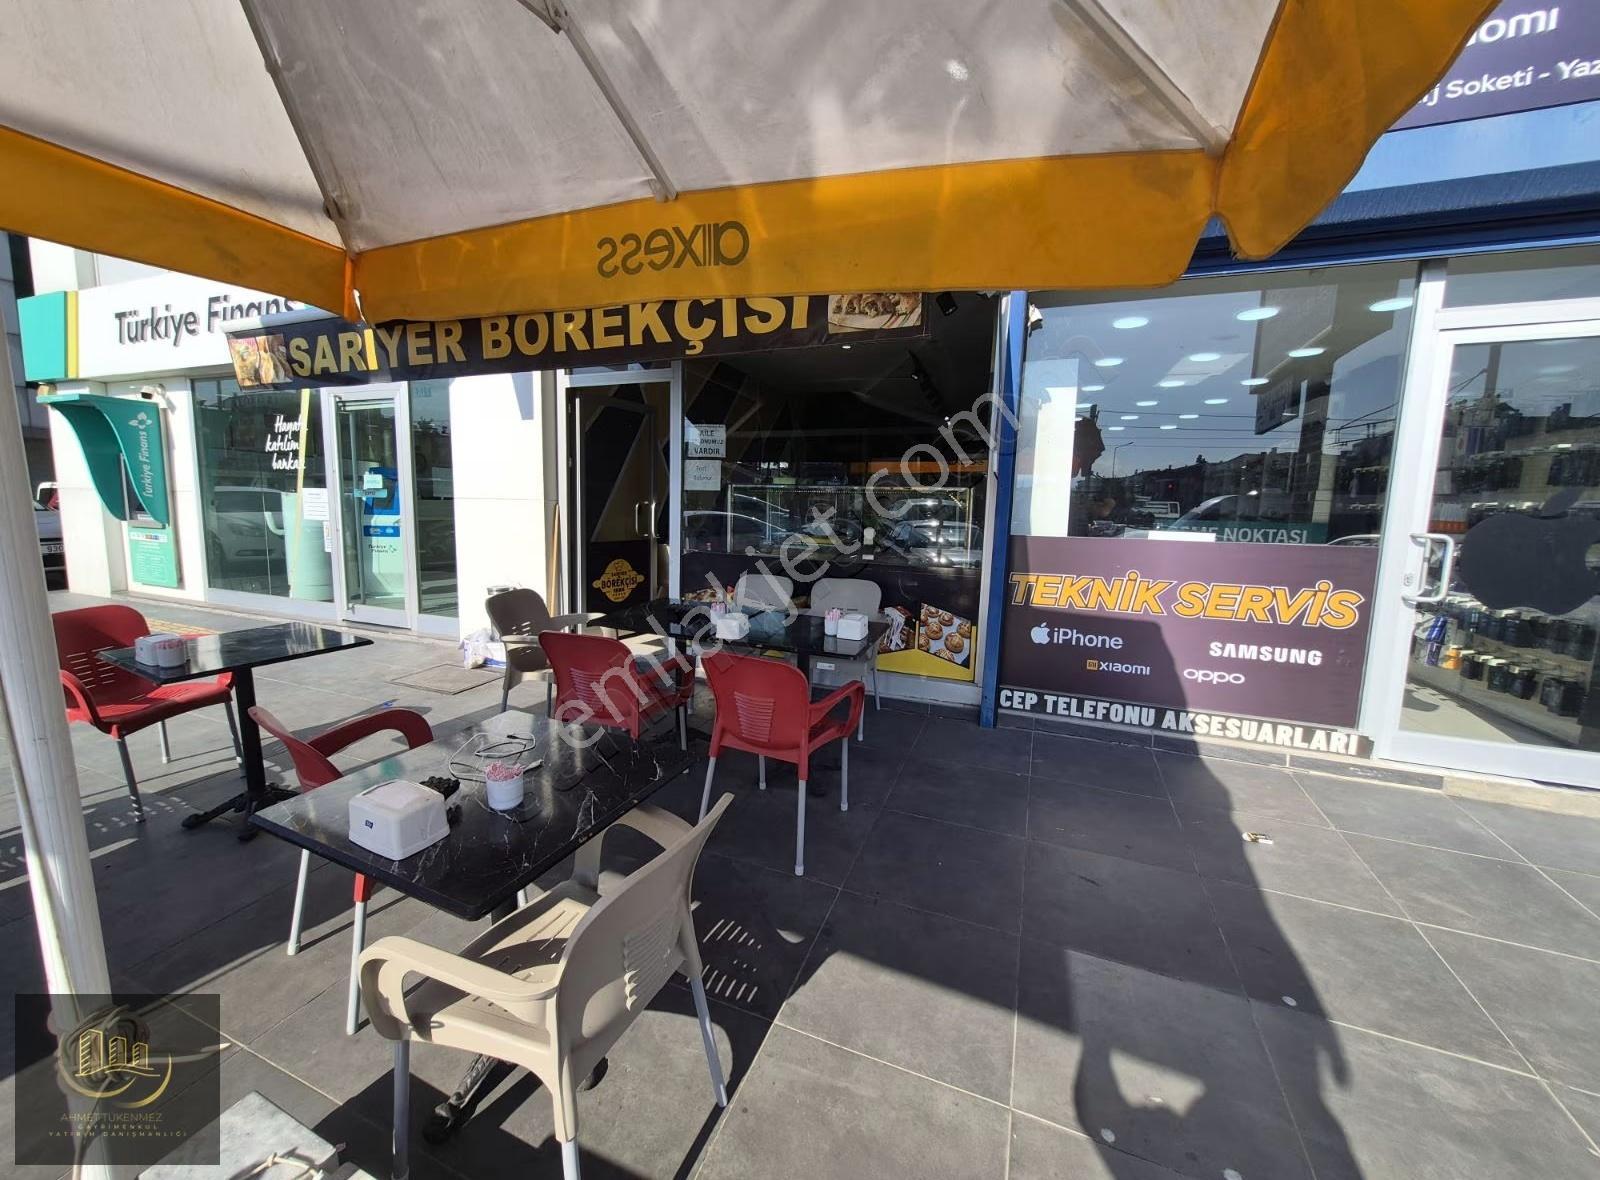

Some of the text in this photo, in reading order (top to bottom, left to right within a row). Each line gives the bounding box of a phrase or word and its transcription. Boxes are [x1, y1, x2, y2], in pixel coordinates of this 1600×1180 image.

[1445, 66, 1535, 98] Soketi
[115, 303, 200, 347] Türkiye
[290, 319, 467, 377] SARIYER
[1009, 569, 1366, 630] TEKNİK SERVİS
[1053, 627, 1124, 650] iPhone
[1209, 641, 1323, 666] SAMSUNG
[1183, 668, 1246, 684] oppo
[999, 689, 1359, 756] CEP TELEFONU AKSESUARLARI
